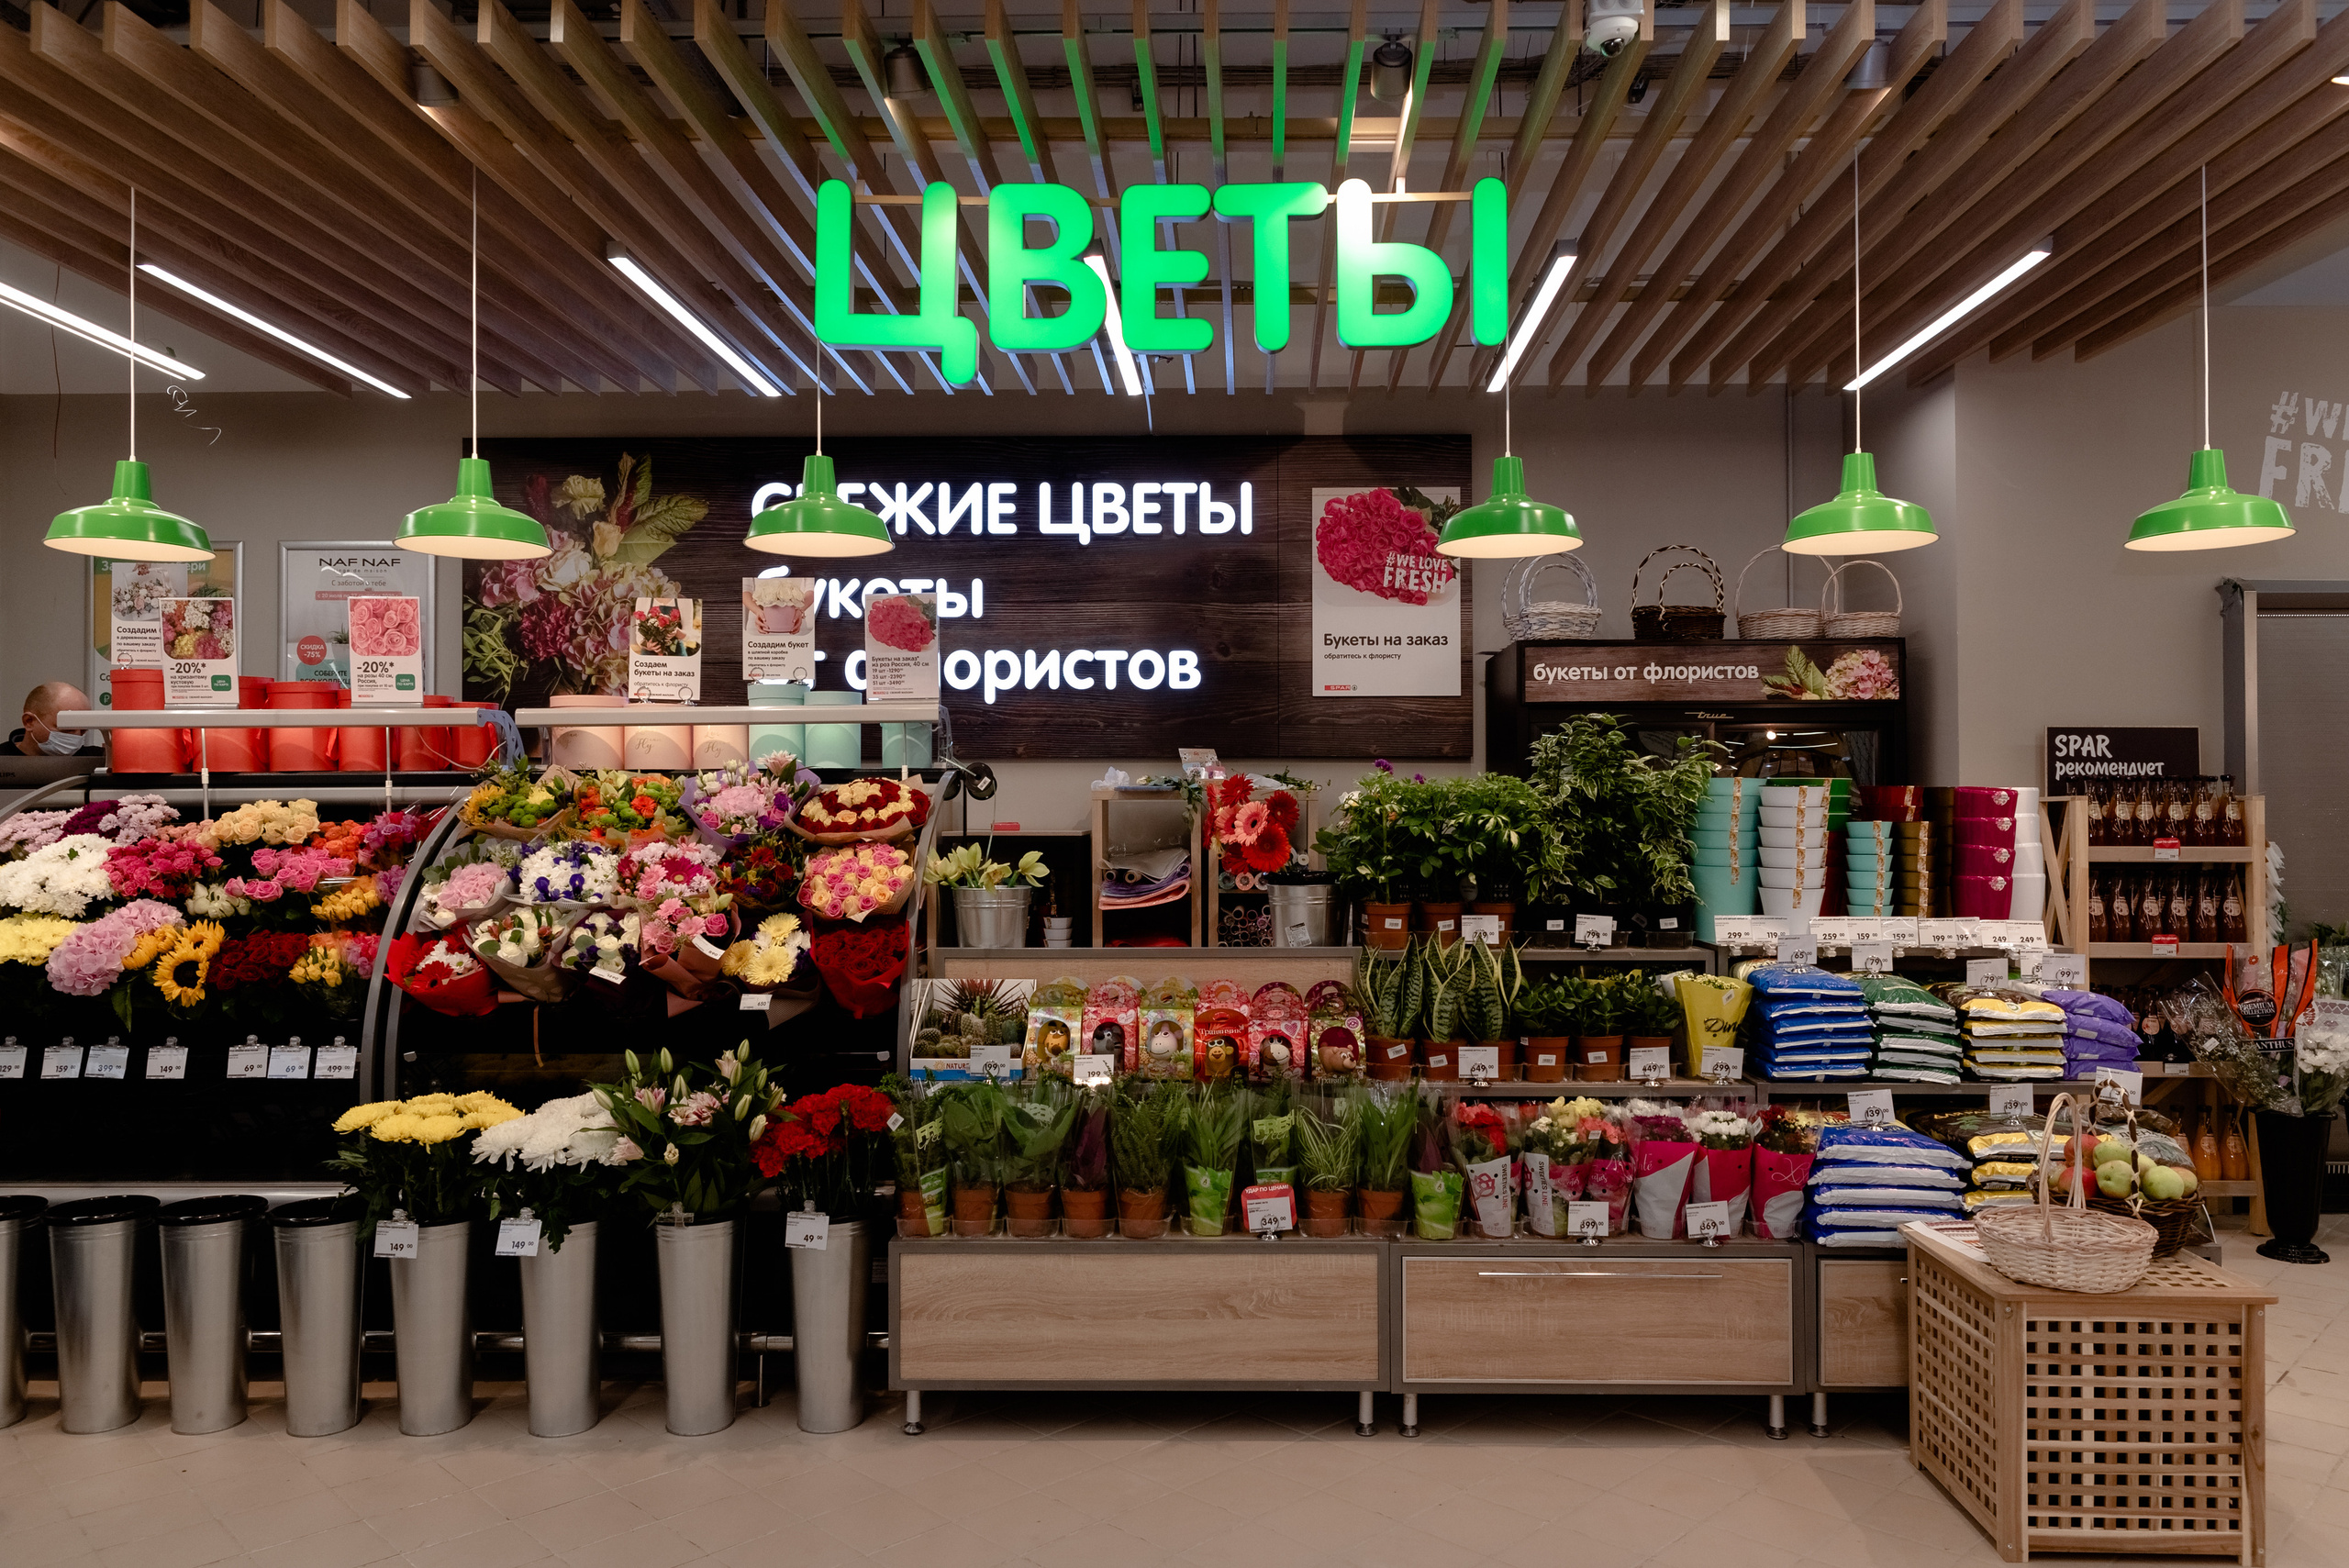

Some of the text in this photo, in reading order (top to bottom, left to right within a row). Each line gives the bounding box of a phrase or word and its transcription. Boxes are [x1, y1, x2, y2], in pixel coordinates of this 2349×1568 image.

[814, 178, 1508, 386] ЦВЕТЫ
[2270, 392, 2349, 440] #W
[1039, 482, 1254, 546] ЦВЕТЫ
[318, 558, 401, 567] NAF NAF
[1386, 551, 1448, 573] #WE LOVE
[1383, 566, 1447, 594] FRESH
[117, 626, 158, 634] Создадим
[1323, 633, 1449, 649] Букеты на заказ
[634, 661, 668, 669] Создаем
[1533, 662, 1759, 684] букеты от флористов
[2054, 735, 2112, 758] SPAR
[2055, 762, 2165, 781] рекомендует
[1262, 1218, 1278, 1226] 349
[511, 1241, 526, 1250] 149
[804, 1234, 814, 1242] 49
[390, 1243, 404, 1251] 149
